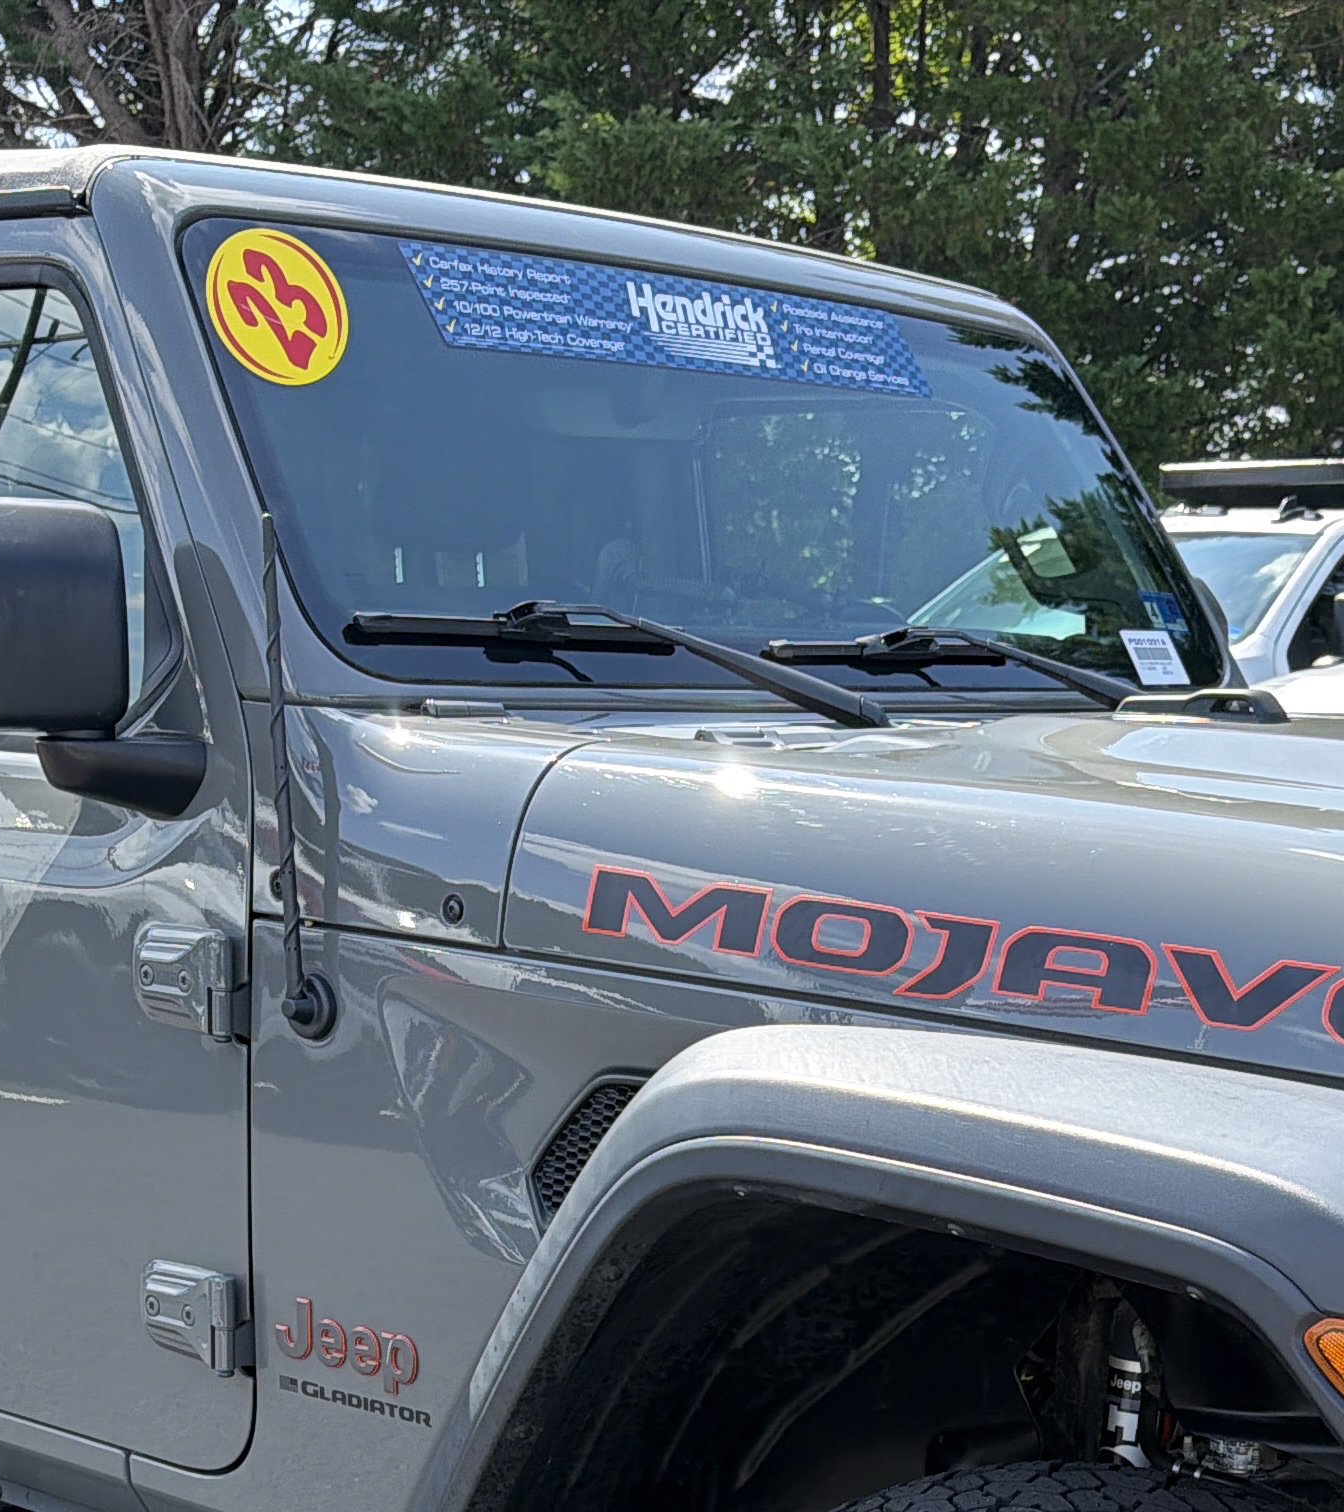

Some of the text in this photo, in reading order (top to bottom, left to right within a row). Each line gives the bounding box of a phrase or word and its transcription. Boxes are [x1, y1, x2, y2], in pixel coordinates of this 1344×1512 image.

[429, 257, 571, 285] Carfax History Report
[440, 277, 569, 304] 257-Point Inspected
[226, 249, 328, 371] 23
[453, 300, 633, 334] 10/100 Powertrain Warranty
[625, 281, 769, 333] Hendrick
[783, 303, 884, 329] Roadside Assistance
[464, 323, 502, 338] 12/12
[506, 327, 564, 345] High-Tech
[567, 333, 625, 352] Coverage
[661, 321, 772, 346] CERTIFIED
[793, 323, 874, 344] Trip Interruption
[803, 343, 885, 366] Rental Coverage
[813, 362, 909, 386] Oil Change Services
[275, 1296, 421, 1396] Jeep
[1111, 1374, 1142, 1394] Jeep
[301, 1381, 433, 1428] GLADIATOR
